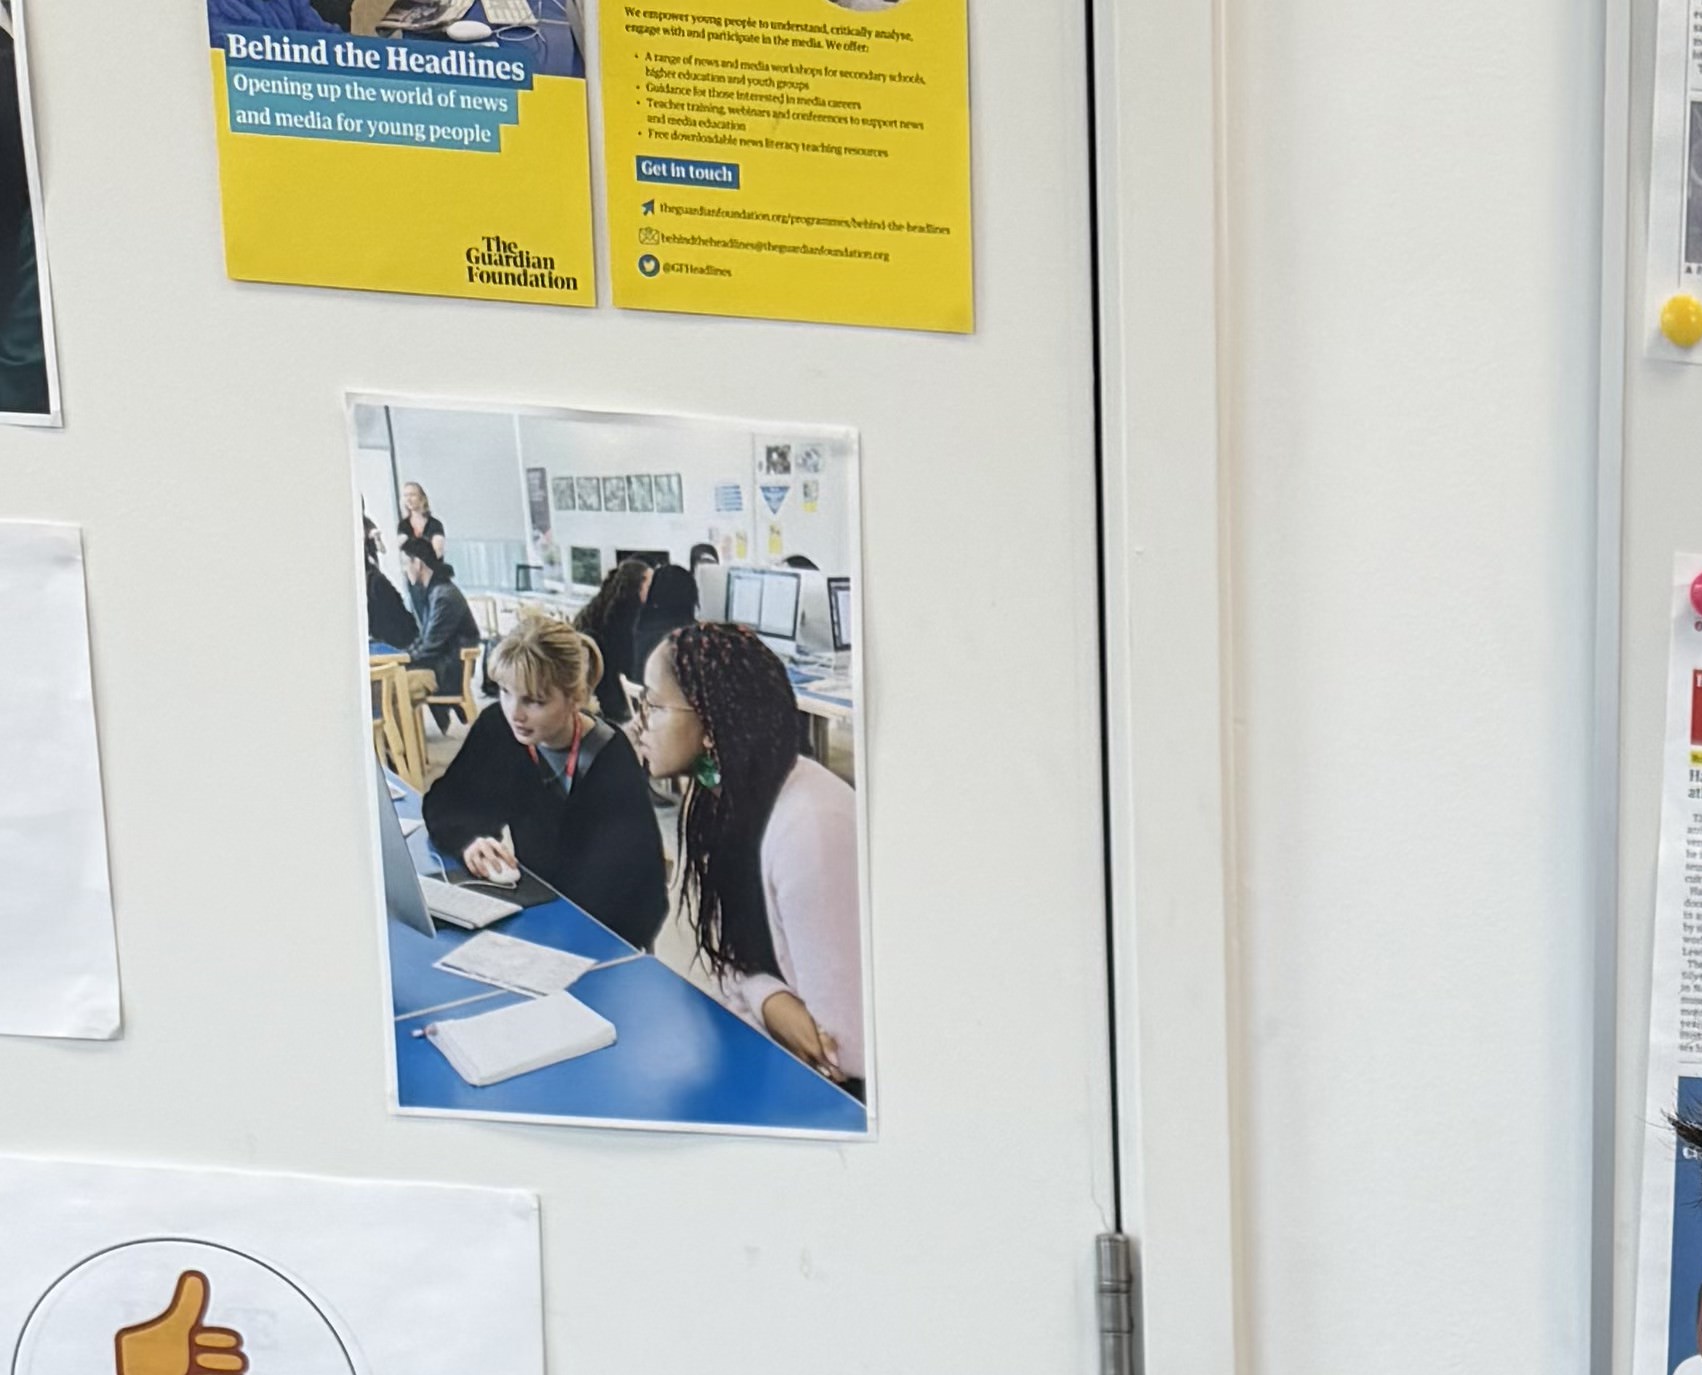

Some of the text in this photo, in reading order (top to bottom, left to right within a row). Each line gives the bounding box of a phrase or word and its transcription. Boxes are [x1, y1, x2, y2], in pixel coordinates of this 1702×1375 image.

[227, 34, 525, 81] Behind the Headlines
[233, 74, 508, 112] Opening up the world of news
[236, 107, 491, 143] and media for young people
[641, 160, 732, 182] Get in touch
[482, 235, 518, 254] The
[466, 247, 555, 270] Guardian
[467, 266, 578, 290] Foundation
